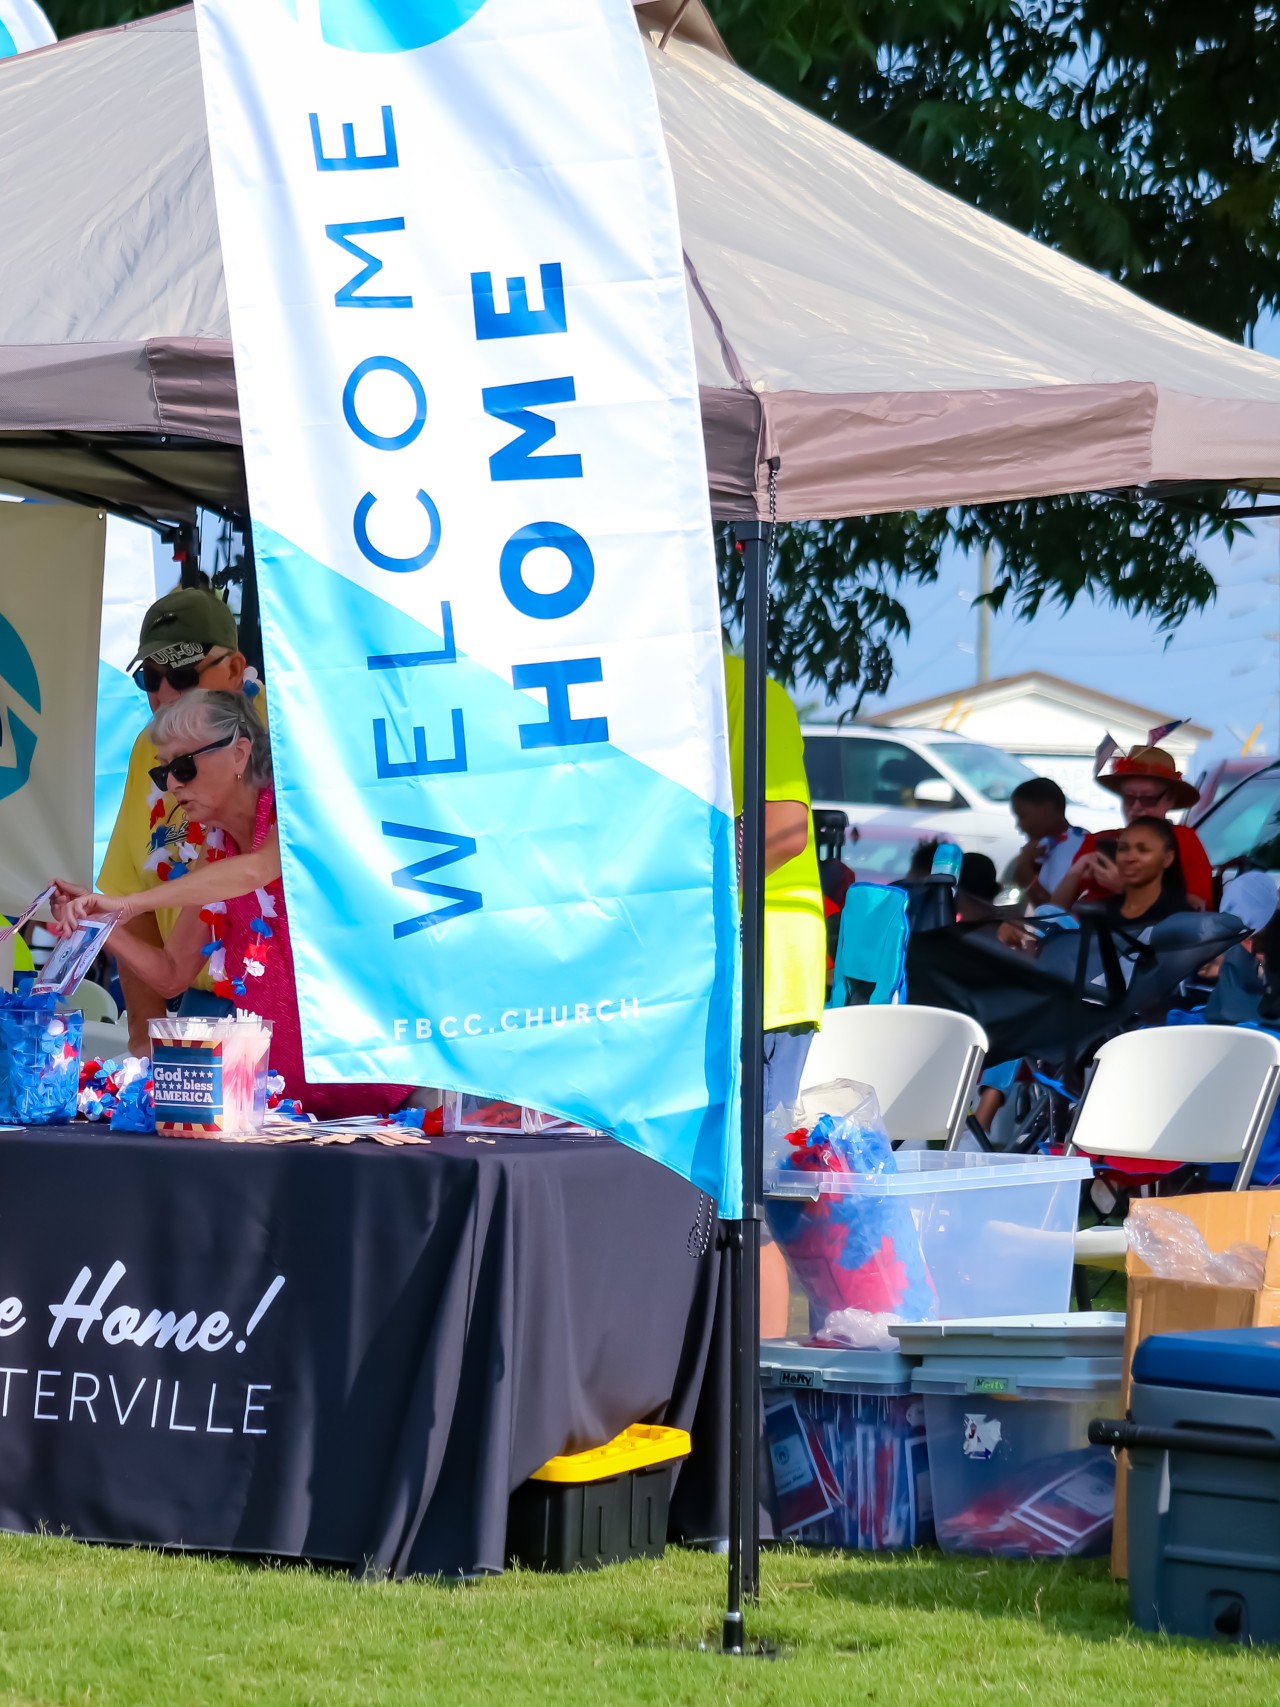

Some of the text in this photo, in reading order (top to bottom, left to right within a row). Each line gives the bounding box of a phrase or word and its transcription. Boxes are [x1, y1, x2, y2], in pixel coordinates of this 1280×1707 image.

[470, 262, 610, 750] HOME
[308, 105, 483, 940] WELCOME
[150, 642, 204, 665] UH-60
[393, 997, 641, 1041] FBCC.CHURCH
[153, 1067, 182, 1082] God
[183, 1079, 213, 1091] bless
[154, 1090, 214, 1103] AMERICA
[47, 1260, 286, 1353] Home!
[782, 1372, 812, 1387] Hefty
